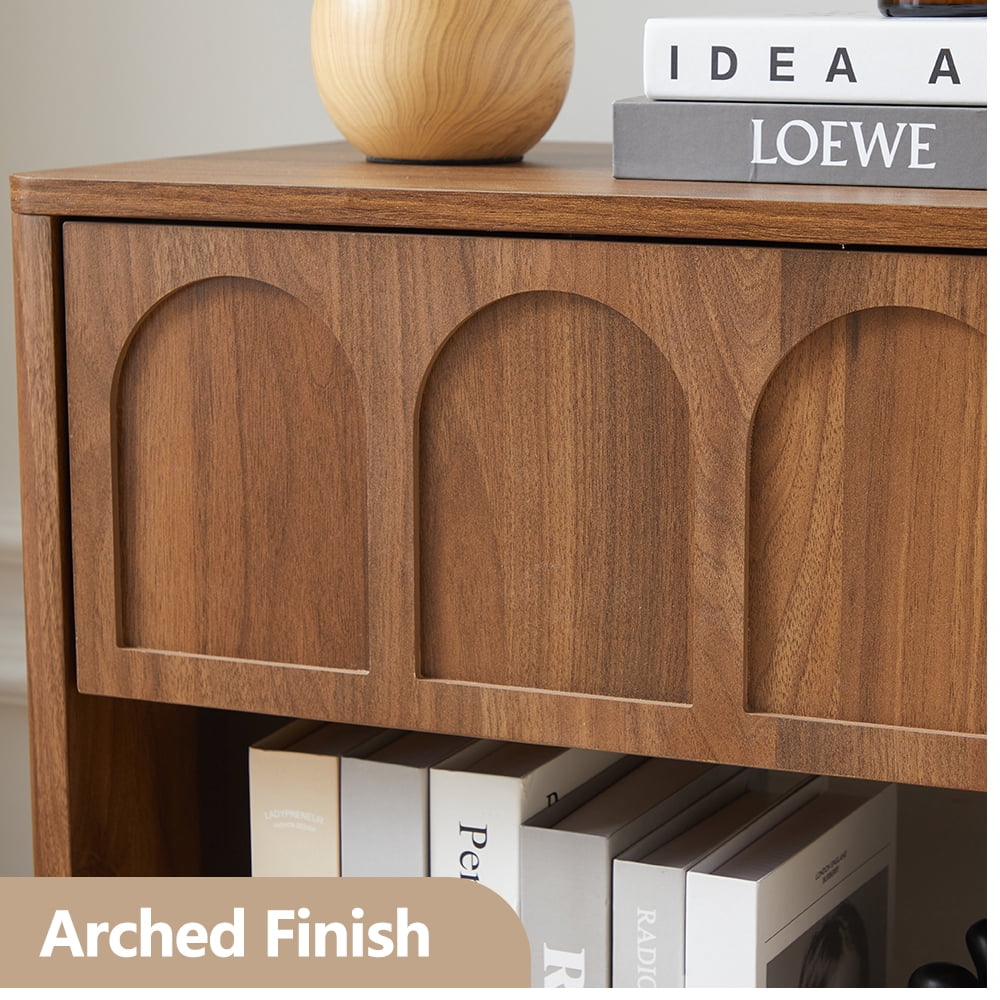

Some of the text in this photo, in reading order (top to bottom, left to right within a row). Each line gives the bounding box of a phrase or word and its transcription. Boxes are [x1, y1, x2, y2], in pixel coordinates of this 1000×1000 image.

[670, 45, 961, 84] IDEA A
[750, 118, 937, 169] LOEWE
